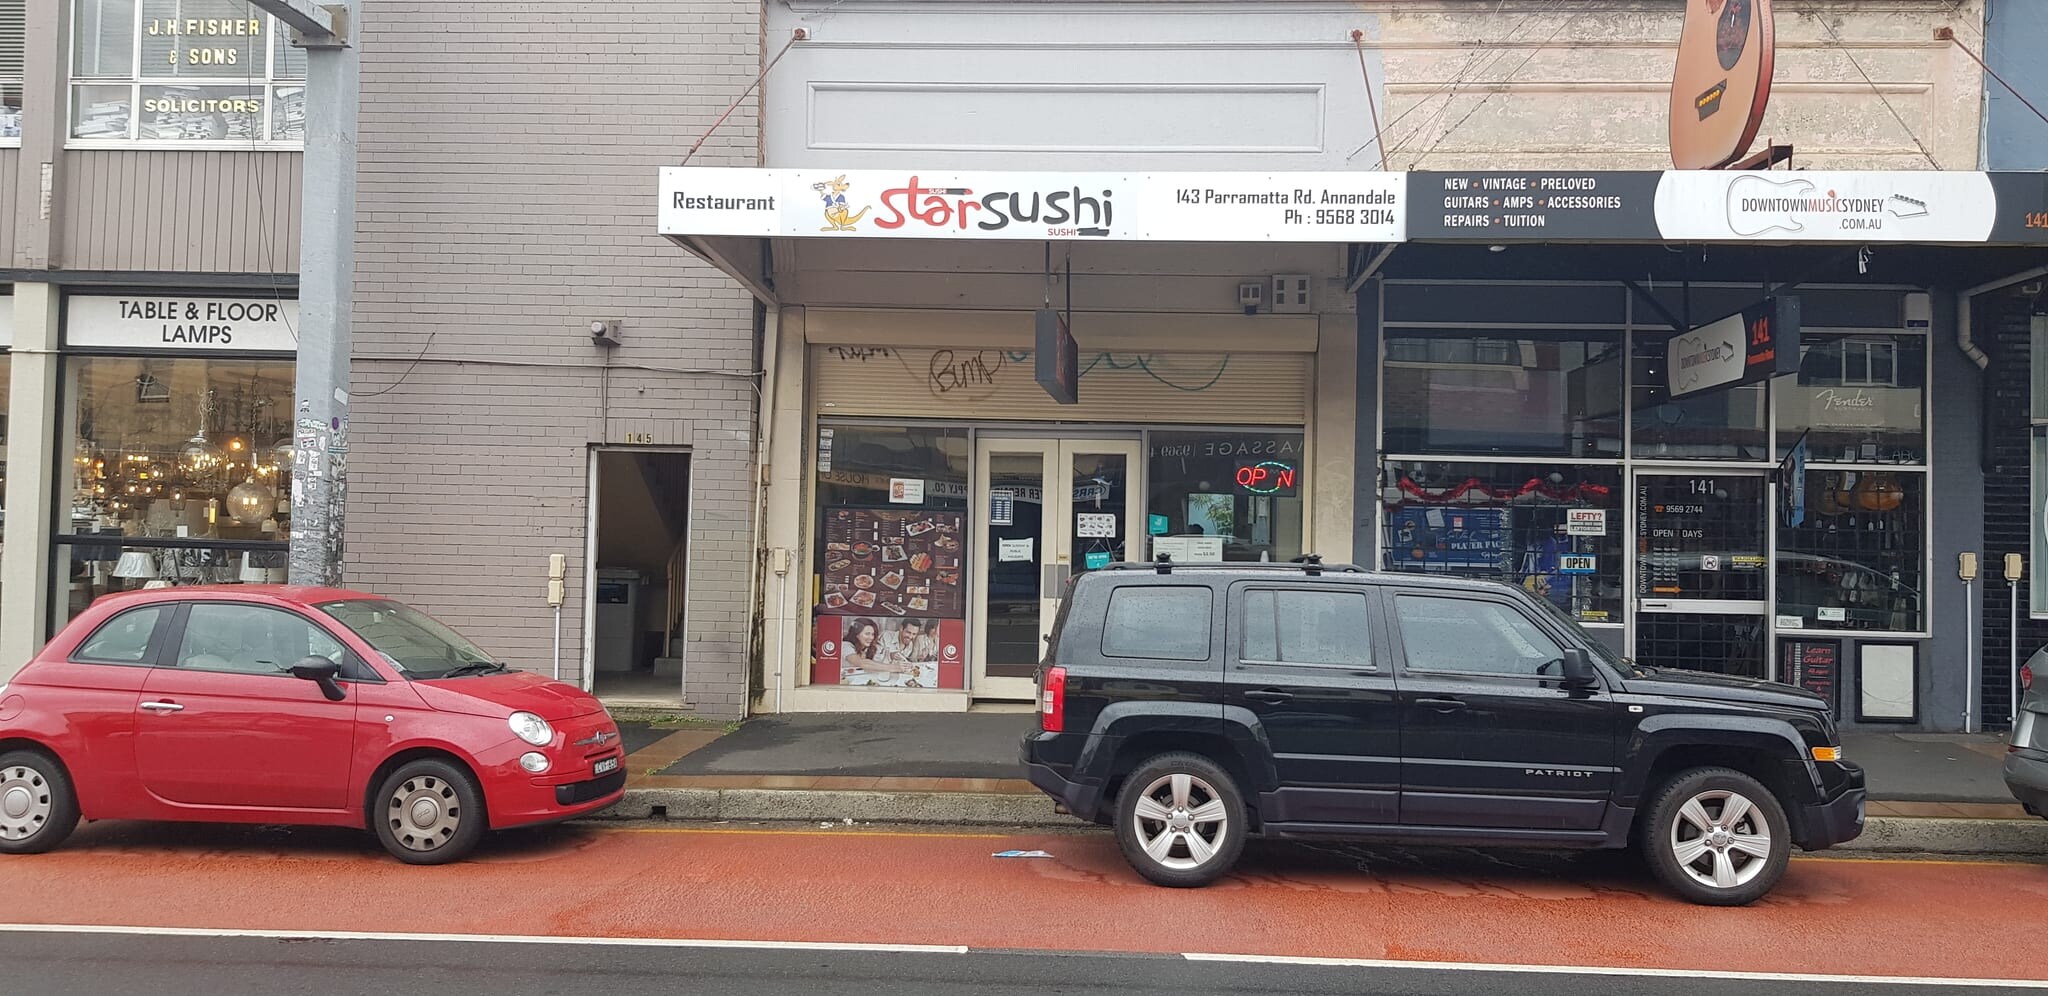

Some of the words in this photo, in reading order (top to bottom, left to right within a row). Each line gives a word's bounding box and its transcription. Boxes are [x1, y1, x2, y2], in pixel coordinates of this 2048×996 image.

[186, 19, 260, 36] FISHER
[169, 50, 177, 65] &
[189, 48, 239, 66] SONS
[144, 98, 261, 115] SOLICITORS
[1444, 178, 1469, 190] NEW
[1482, 178, 1527, 191] VINTAGE
[1540, 178, 1596, 191] PRELOVED
[672, 190, 776, 212] Restaurant
[1176, 189, 1201, 204] 143
[1204, 188, 1290, 205] Parramatta
[1293, 188, 1316, 205] Rd.
[1320, 188, 1396, 205] Annandale
[1444, 196, 1490, 209] GUITARS
[1502, 196, 1534, 209] AMPS
[1547, 196, 1621, 209] ACCESSORIES
[1284, 210, 1303, 225] Ph
[1315, 210, 1355, 226] 9568
[1360, 210, 1395, 226] 3014
[1444, 214, 1490, 227] REPAIRS
[1503, 214, 1545, 227] TUITION
[1839, 217, 1883, 231] .COM.AU
[2025, 212, 2048, 229] 141
[1047, 228, 1077, 237] SUSHI
[119, 300, 179, 321] TABLE
[184, 301, 200, 321] &
[206, 301, 279, 323] FLOOR
[161, 323, 233, 345] LAMPS
[1751, 316, 1771, 346] 141
[1815, 388, 1874, 411] Fender
[628, 434, 652, 444] 145
[1236, 466, 1296, 488] OPN
[1689, 479, 1715, 495] 141
[1665, 505, 1684, 513] 9569
[1685, 505, 1703, 513] 2744
[1652, 529, 1674, 538] OPEN
[1682, 530, 1703, 538] DAYS
[1566, 558, 1591, 569] OPEN
[1805, 646, 1832, 655] Learn
[1803, 655, 1834, 665] Guitar
[1526, 769, 1593, 777] PATRIOT
